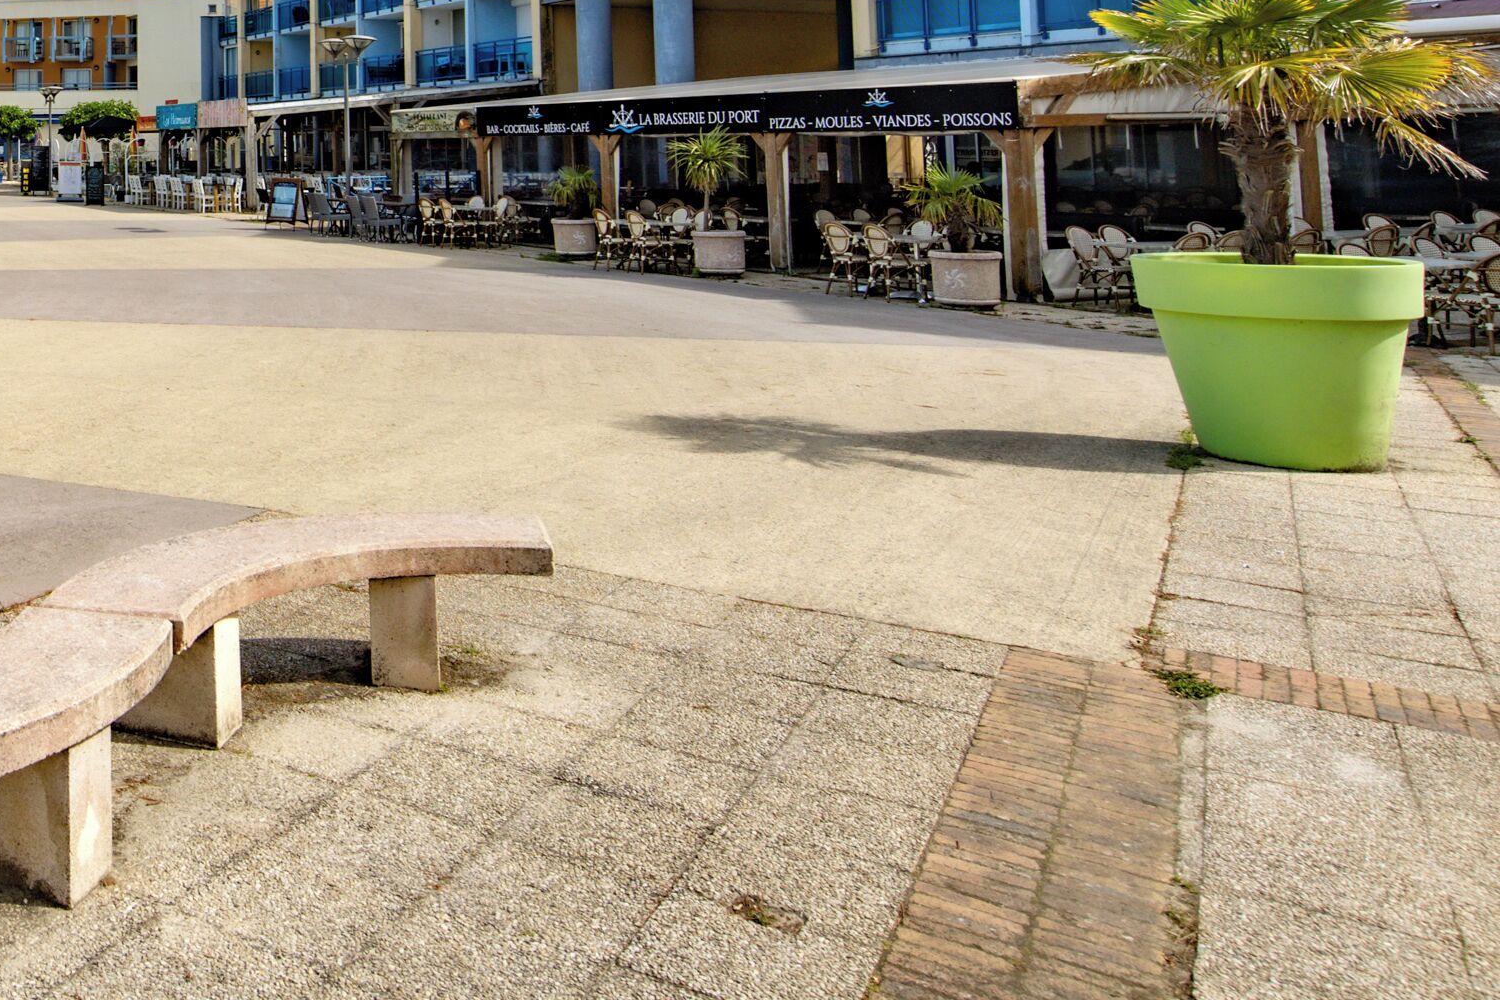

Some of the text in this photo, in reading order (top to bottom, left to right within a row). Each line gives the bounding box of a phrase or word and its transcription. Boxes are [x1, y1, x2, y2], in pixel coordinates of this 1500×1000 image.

[639, 109, 760, 126] LA BRASSERIE DU PORT
[769, 117, 806, 129] PIZZAS
[815, 115, 863, 128] MOULES
[872, 114, 932, 128] VIANDES
[942, 112, 1013, 127] POISSONS
[486, 124, 500, 134] BAR
[503, 123, 540, 134] COCKTAILS
[543, 121, 566, 133] BIÈRES
[570, 120, 590, 133] CAFÉ
